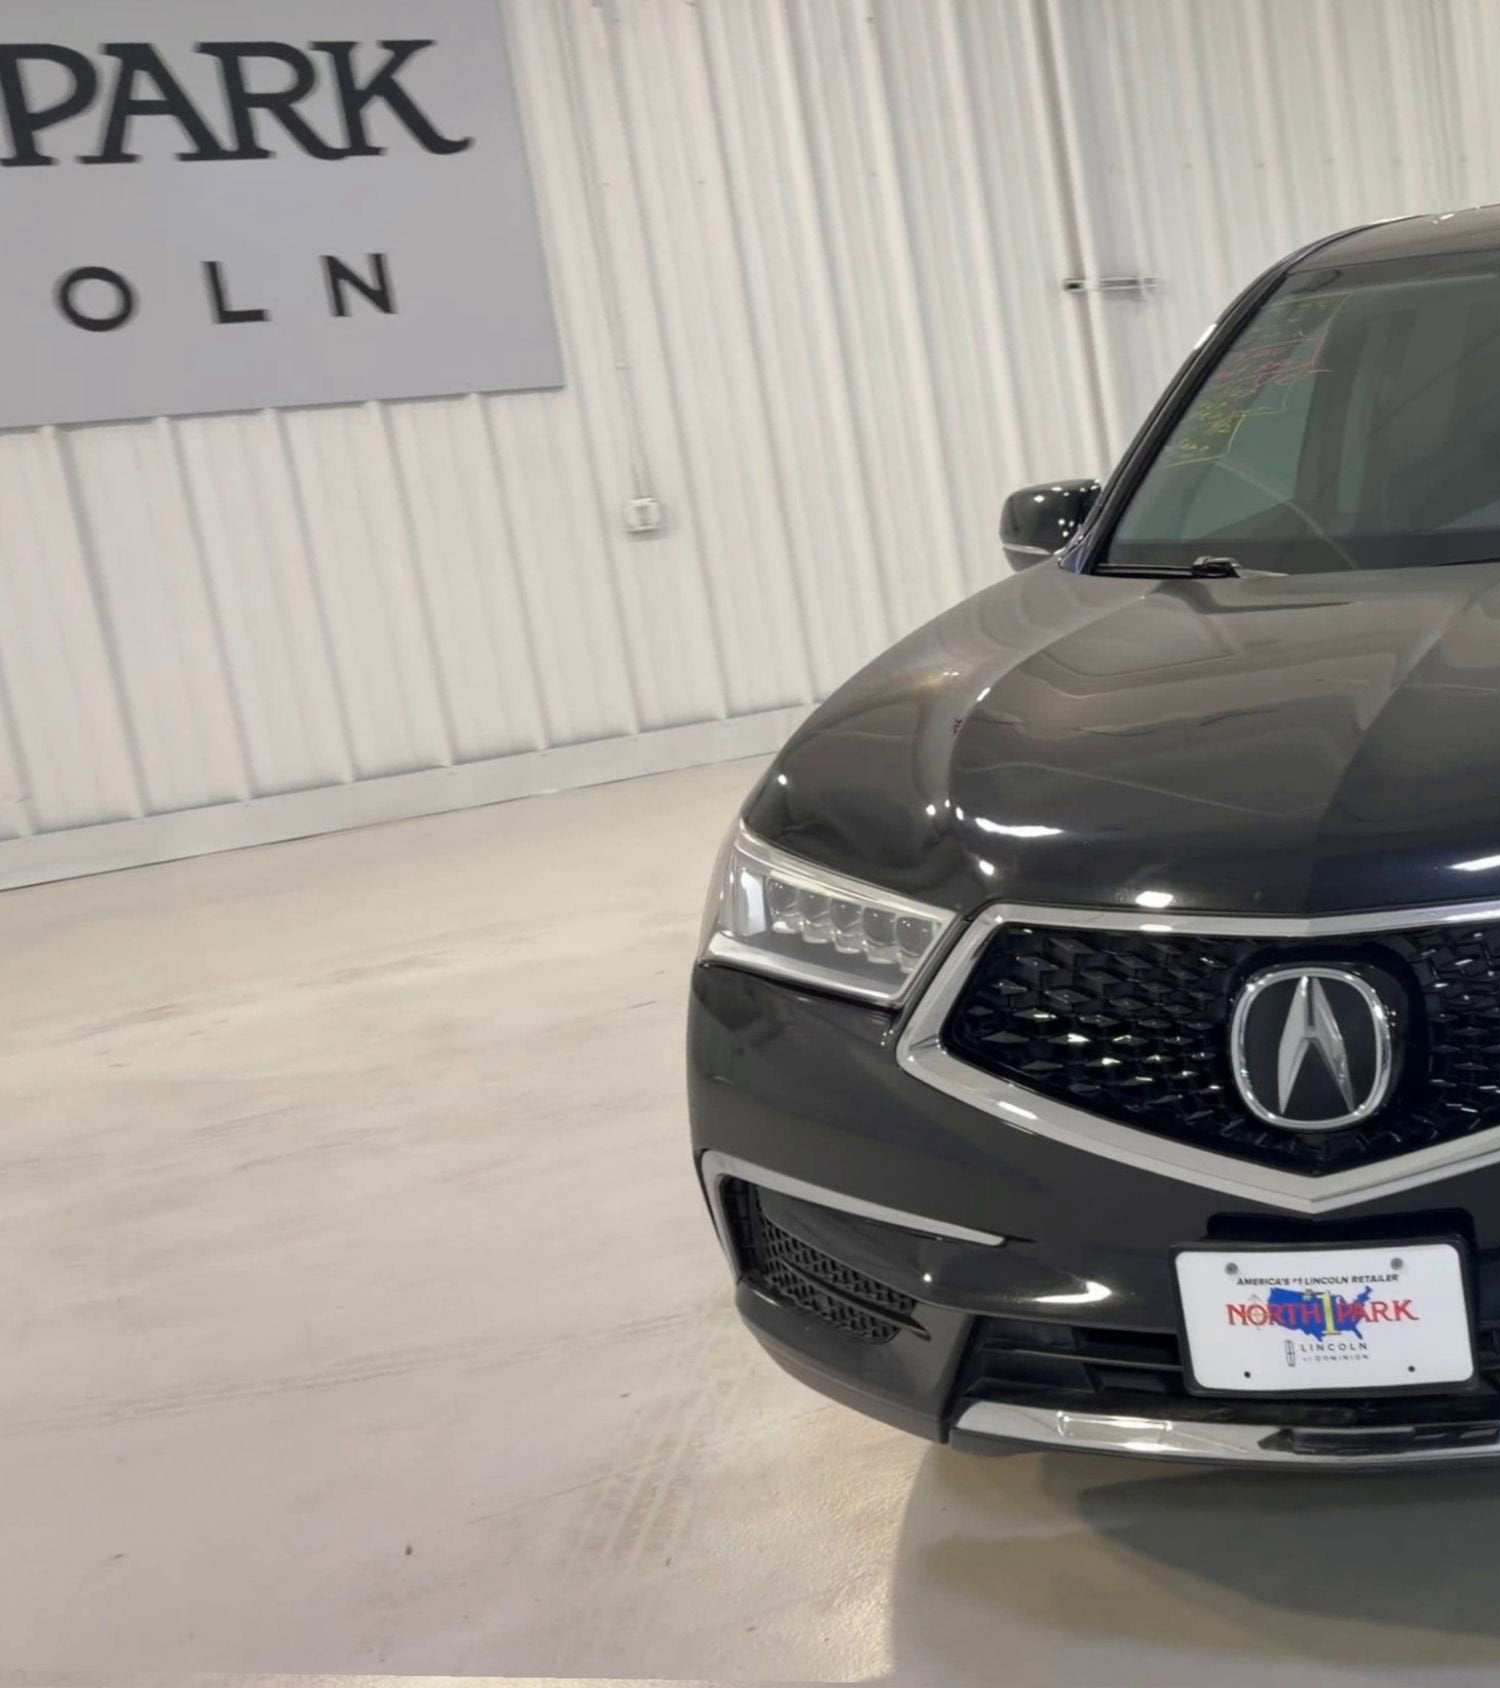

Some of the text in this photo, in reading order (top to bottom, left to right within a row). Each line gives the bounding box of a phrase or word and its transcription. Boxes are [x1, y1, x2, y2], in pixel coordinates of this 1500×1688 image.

[0, 39, 474, 167] PARK
[1236, 1277, 1290, 1286] AMERICA'S
[1304, 1276, 1348, 1285] LINCOLN
[1351, 1274, 1399, 1283] RETAILER
[1226, 1300, 1419, 1325] NORTH PARK
[1300, 1342, 1368, 1352] LINCOLN
